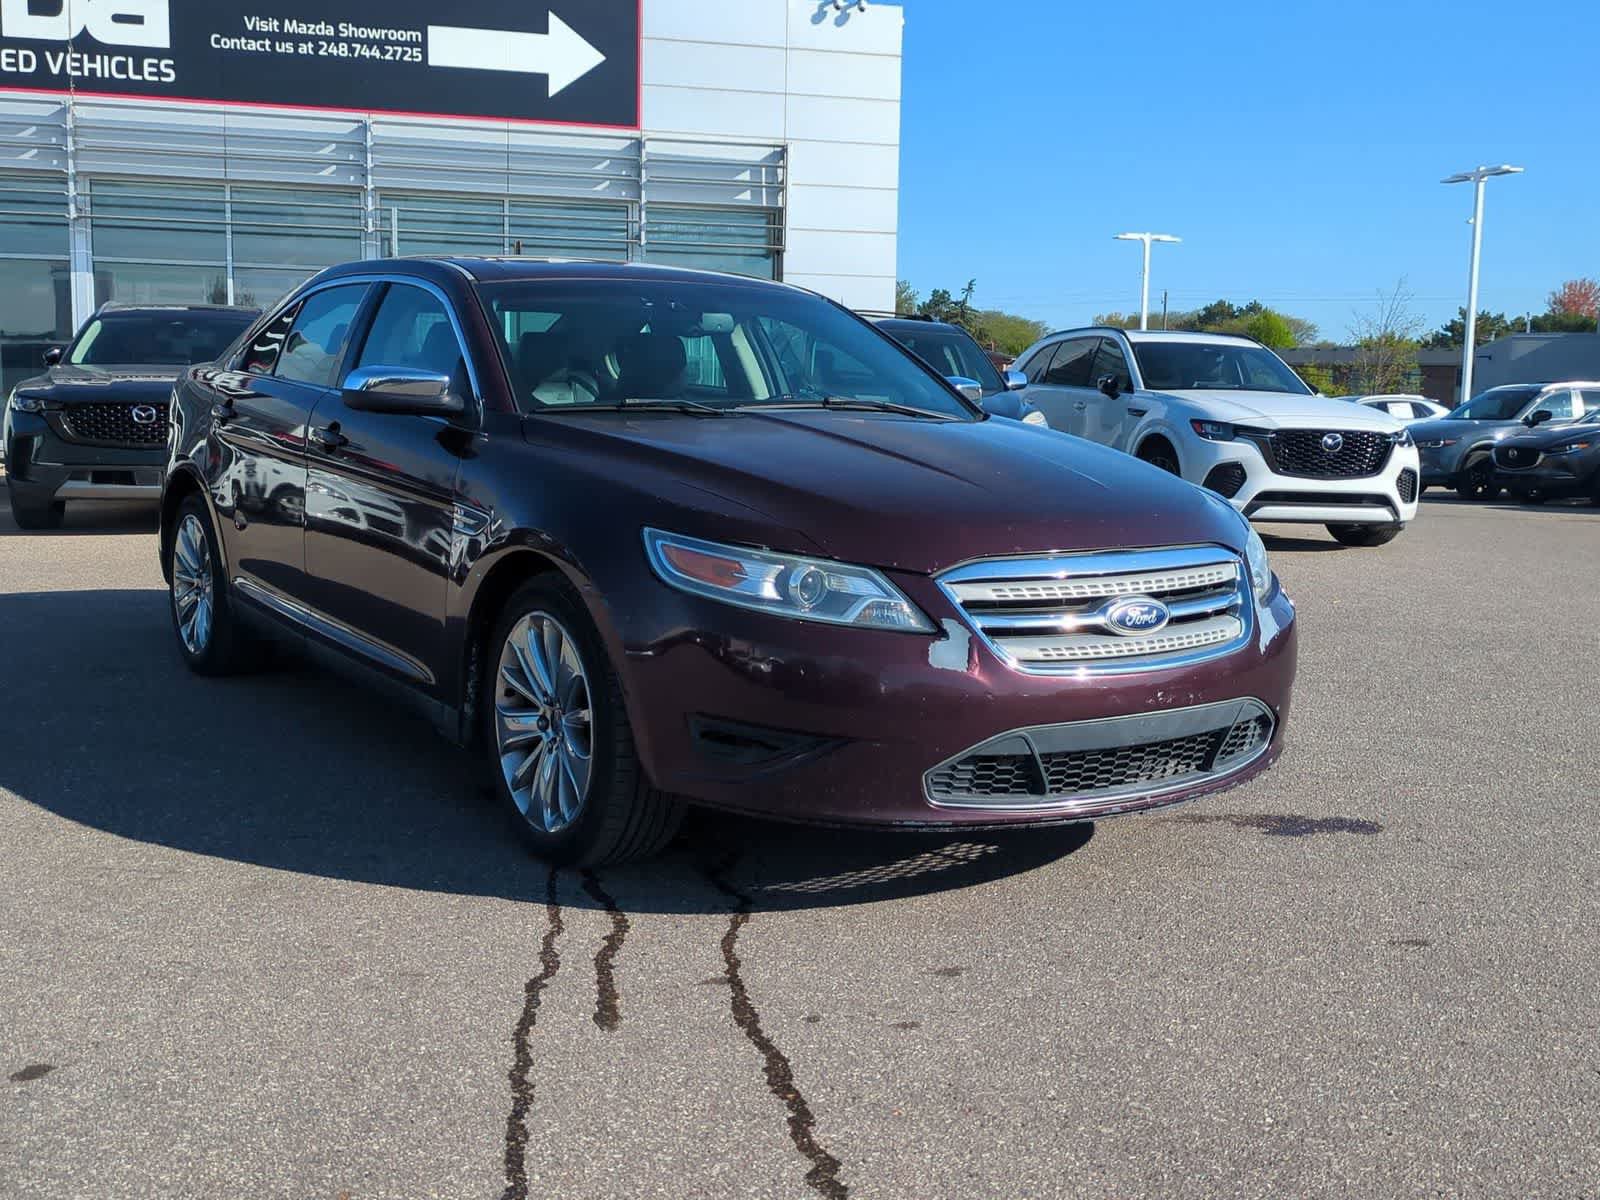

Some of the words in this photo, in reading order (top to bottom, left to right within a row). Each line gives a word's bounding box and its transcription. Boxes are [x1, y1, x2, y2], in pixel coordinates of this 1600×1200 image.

[244, 16, 279, 32] Visit
[284, 19, 334, 36] Mazda
[338, 23, 422, 42] Showroom
[210, 34, 271, 51] Contact
[276, 40, 294, 53] us
[298, 41, 314, 55] at
[318, 42, 422, 62] 248.744.2725
[45, 51, 176, 82] VEHICLES
[1125, 606, 1158, 626] Ford
